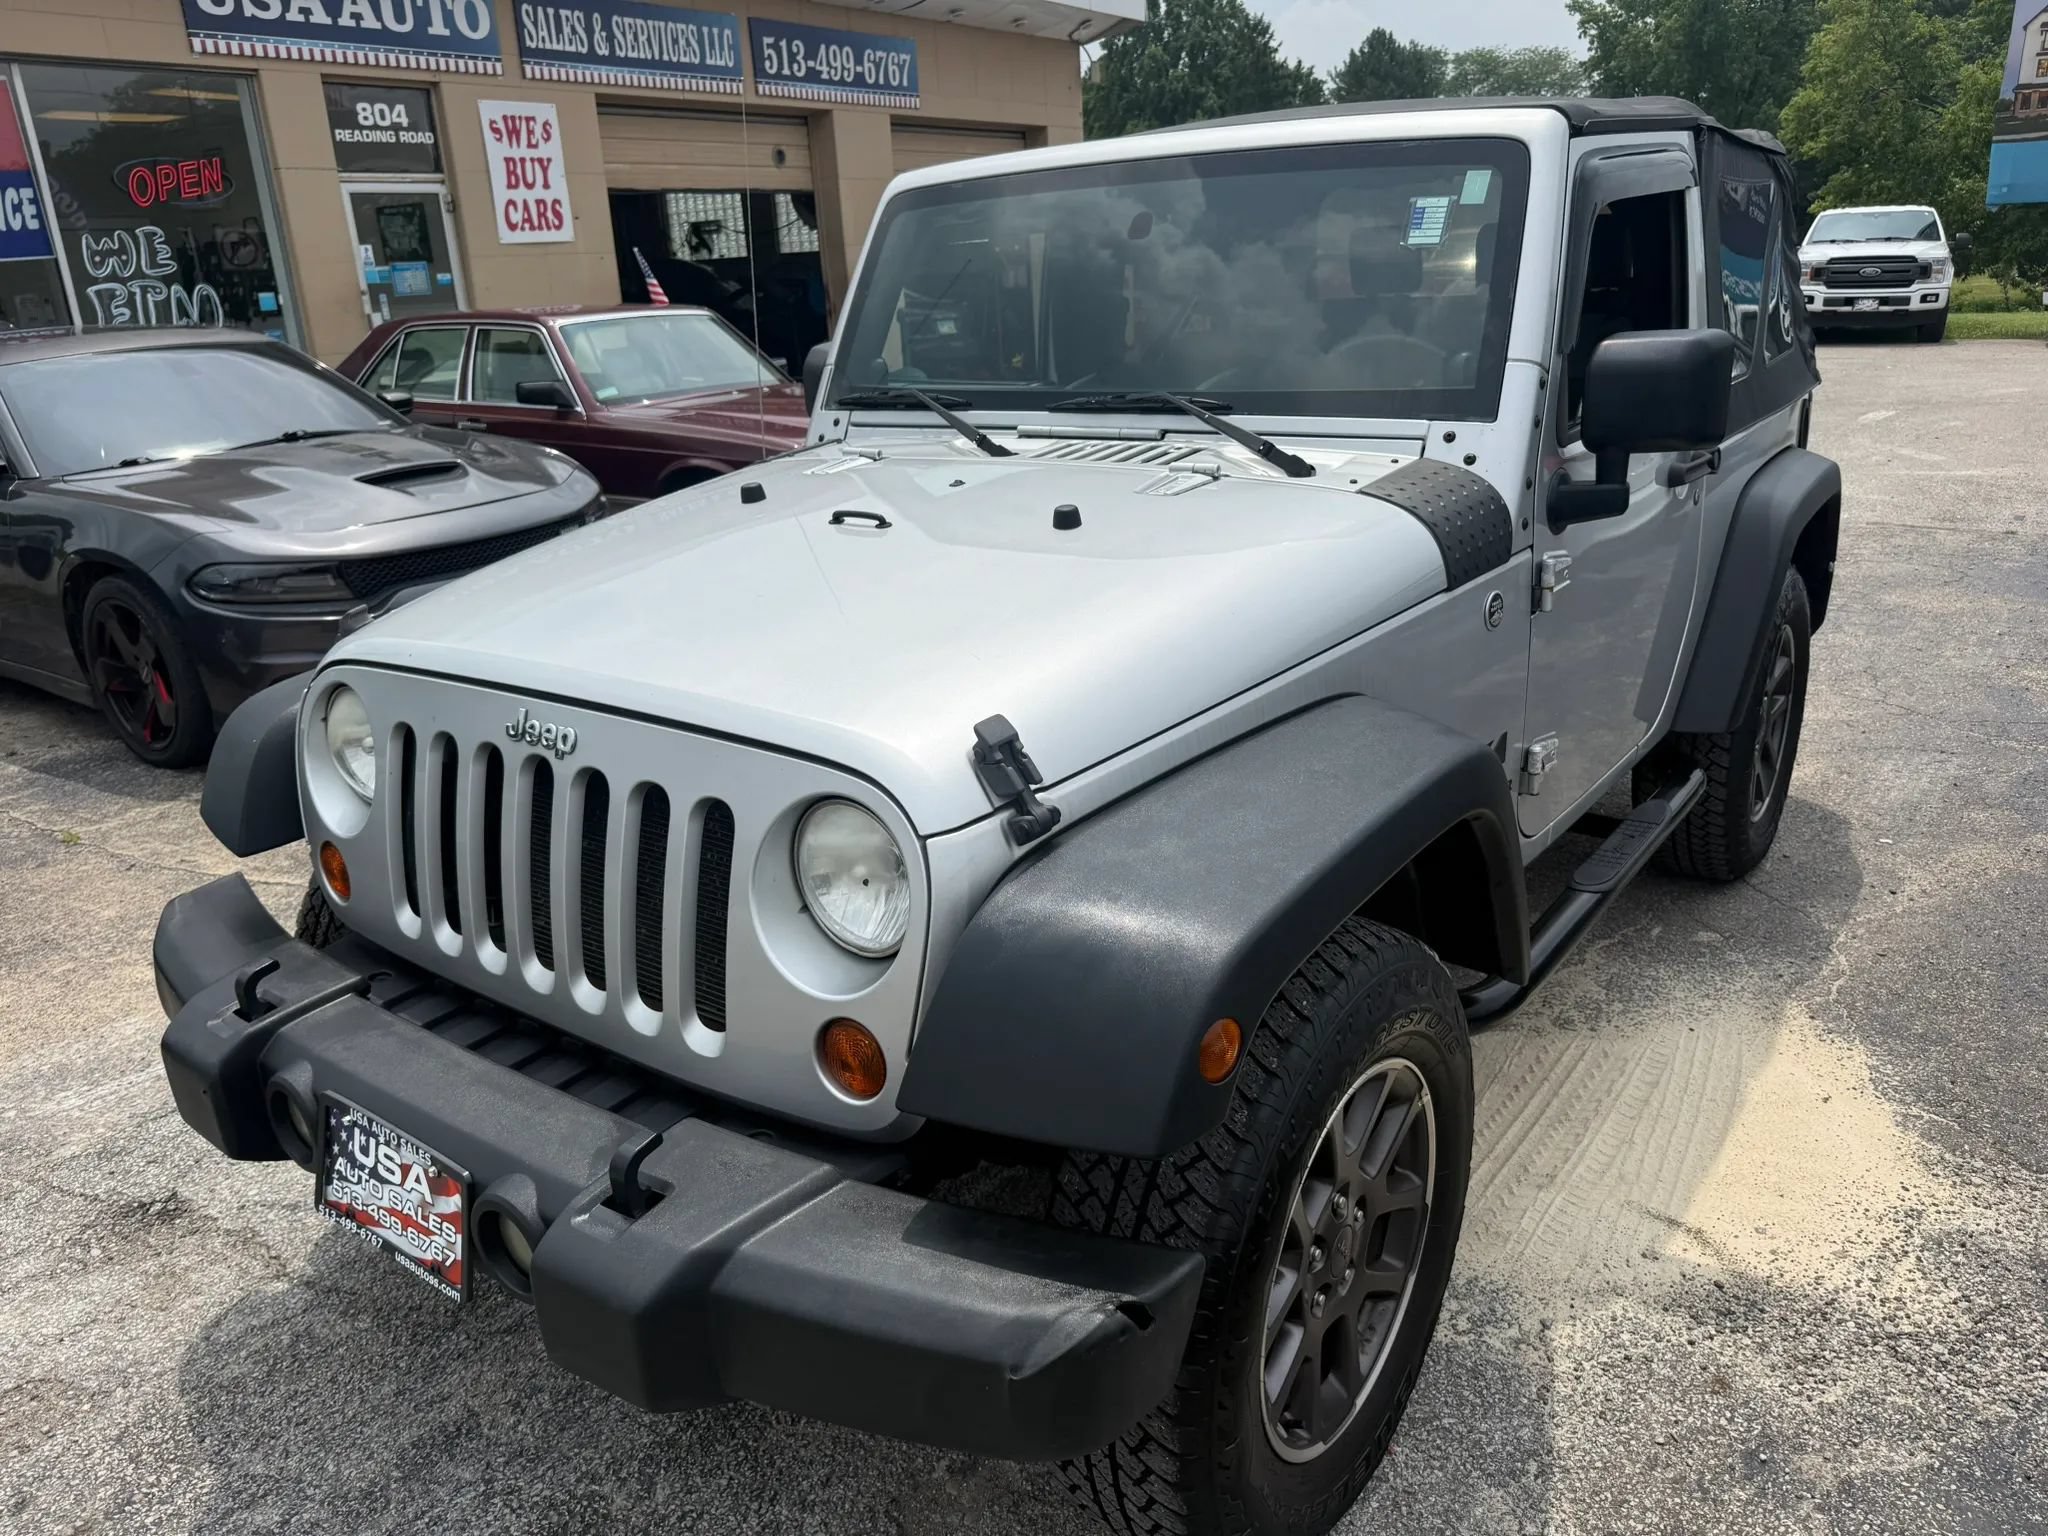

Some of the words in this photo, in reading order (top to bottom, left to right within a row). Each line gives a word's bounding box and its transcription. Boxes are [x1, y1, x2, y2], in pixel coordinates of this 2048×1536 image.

[337, 0, 491, 40] AUTO
[523, 2, 588, 55] SALES
[593, 17, 610, 56] &
[613, 14, 700, 65] SERVICES
[703, 29, 735, 69] LLC
[762, 36, 912, 88] 513-499-6767
[334, 129, 396, 143] READING
[399, 130, 435, 145] ROAD
[356, 102, 409, 127] 804
[128, 157, 223, 208] OPEN
[503, 157, 552, 190] BUY
[0, 187, 40, 232] CE
[504, 198, 564, 232] CARS
[82, 226, 177, 277] WE
[505, 707, 578, 760] Jeep
[350, 1108, 370, 1128] USA
[372, 1122, 398, 1145] AUTO
[400, 1138, 432, 1166] SALES
[353, 1127, 434, 1205] USA
[333, 1156, 384, 1200] AUTO
[388, 1189, 457, 1244] SALES
[318, 1206, 383, 1249] 513-499-6767
[395, 1251, 461, 1302] usaautoss.com
